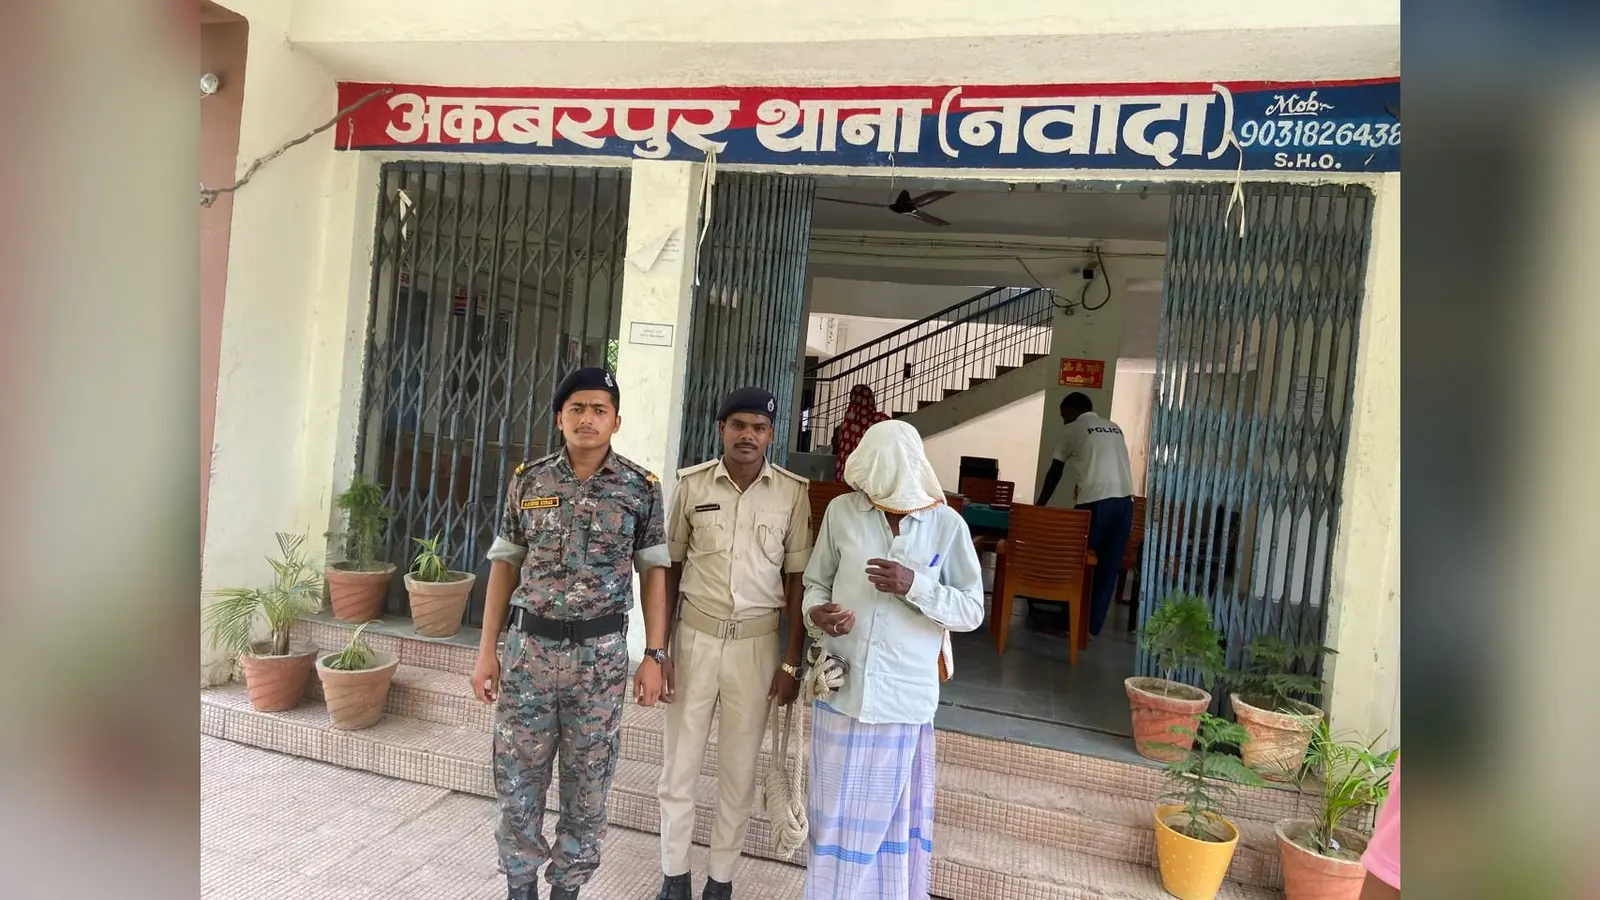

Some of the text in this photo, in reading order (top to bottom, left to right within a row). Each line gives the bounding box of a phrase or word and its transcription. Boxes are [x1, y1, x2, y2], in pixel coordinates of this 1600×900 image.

[385, 83, 1233, 166] अकबरपुर थाना (नवादा)
[1239, 120, 1400, 148] 9031826438
[1274, 152, 1342, 169] S.H.O.
[1087, 427, 1123, 435] POLIC
